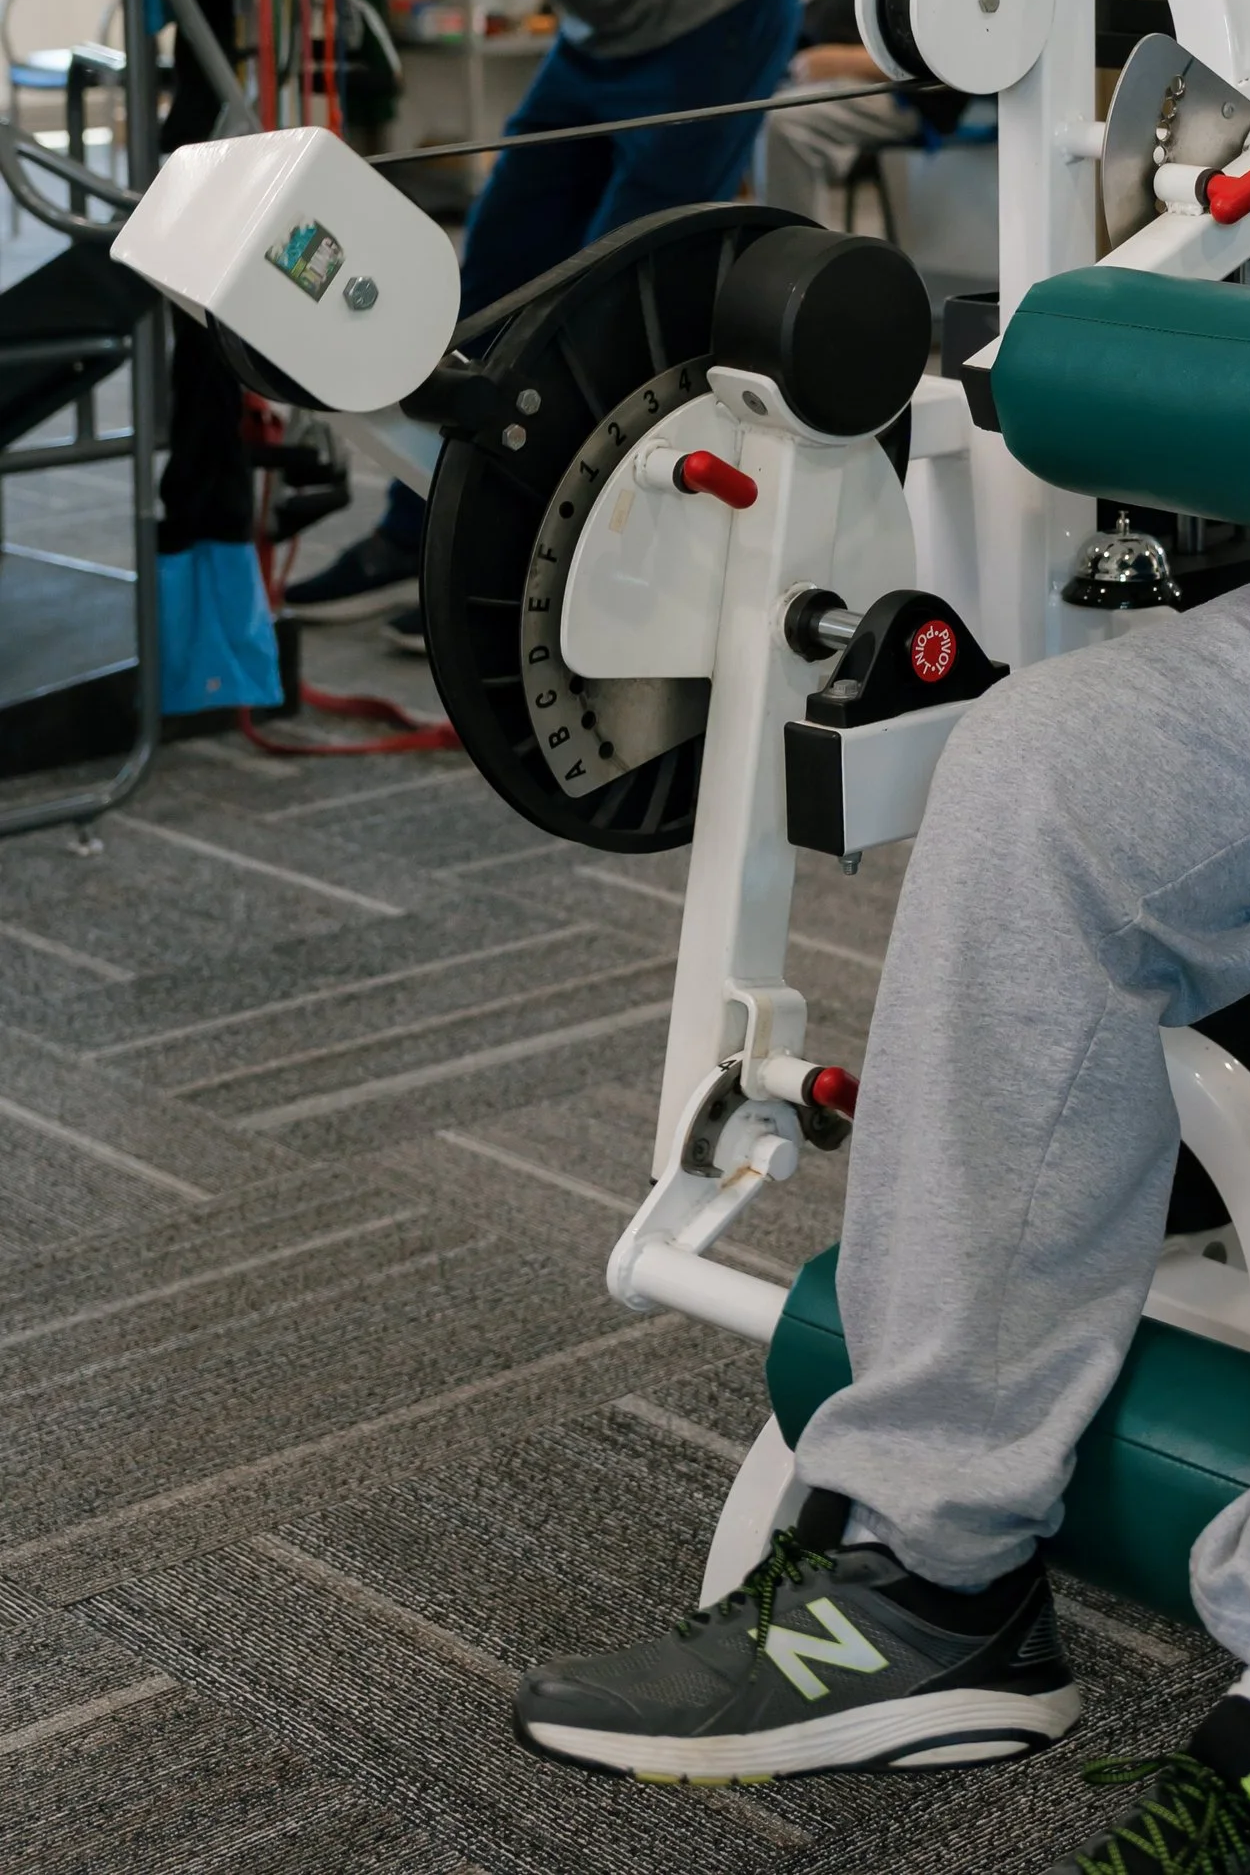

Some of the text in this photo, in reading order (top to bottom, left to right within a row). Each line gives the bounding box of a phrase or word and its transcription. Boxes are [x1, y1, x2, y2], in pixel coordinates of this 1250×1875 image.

[580, 368, 692, 483] 1 2 3 4
[528, 544, 587, 781] A B C D E F
[914, 625, 952, 676] PIVOT POINT
[718, 1059, 737, 1072] 4
[747, 1596, 891, 1701] N
